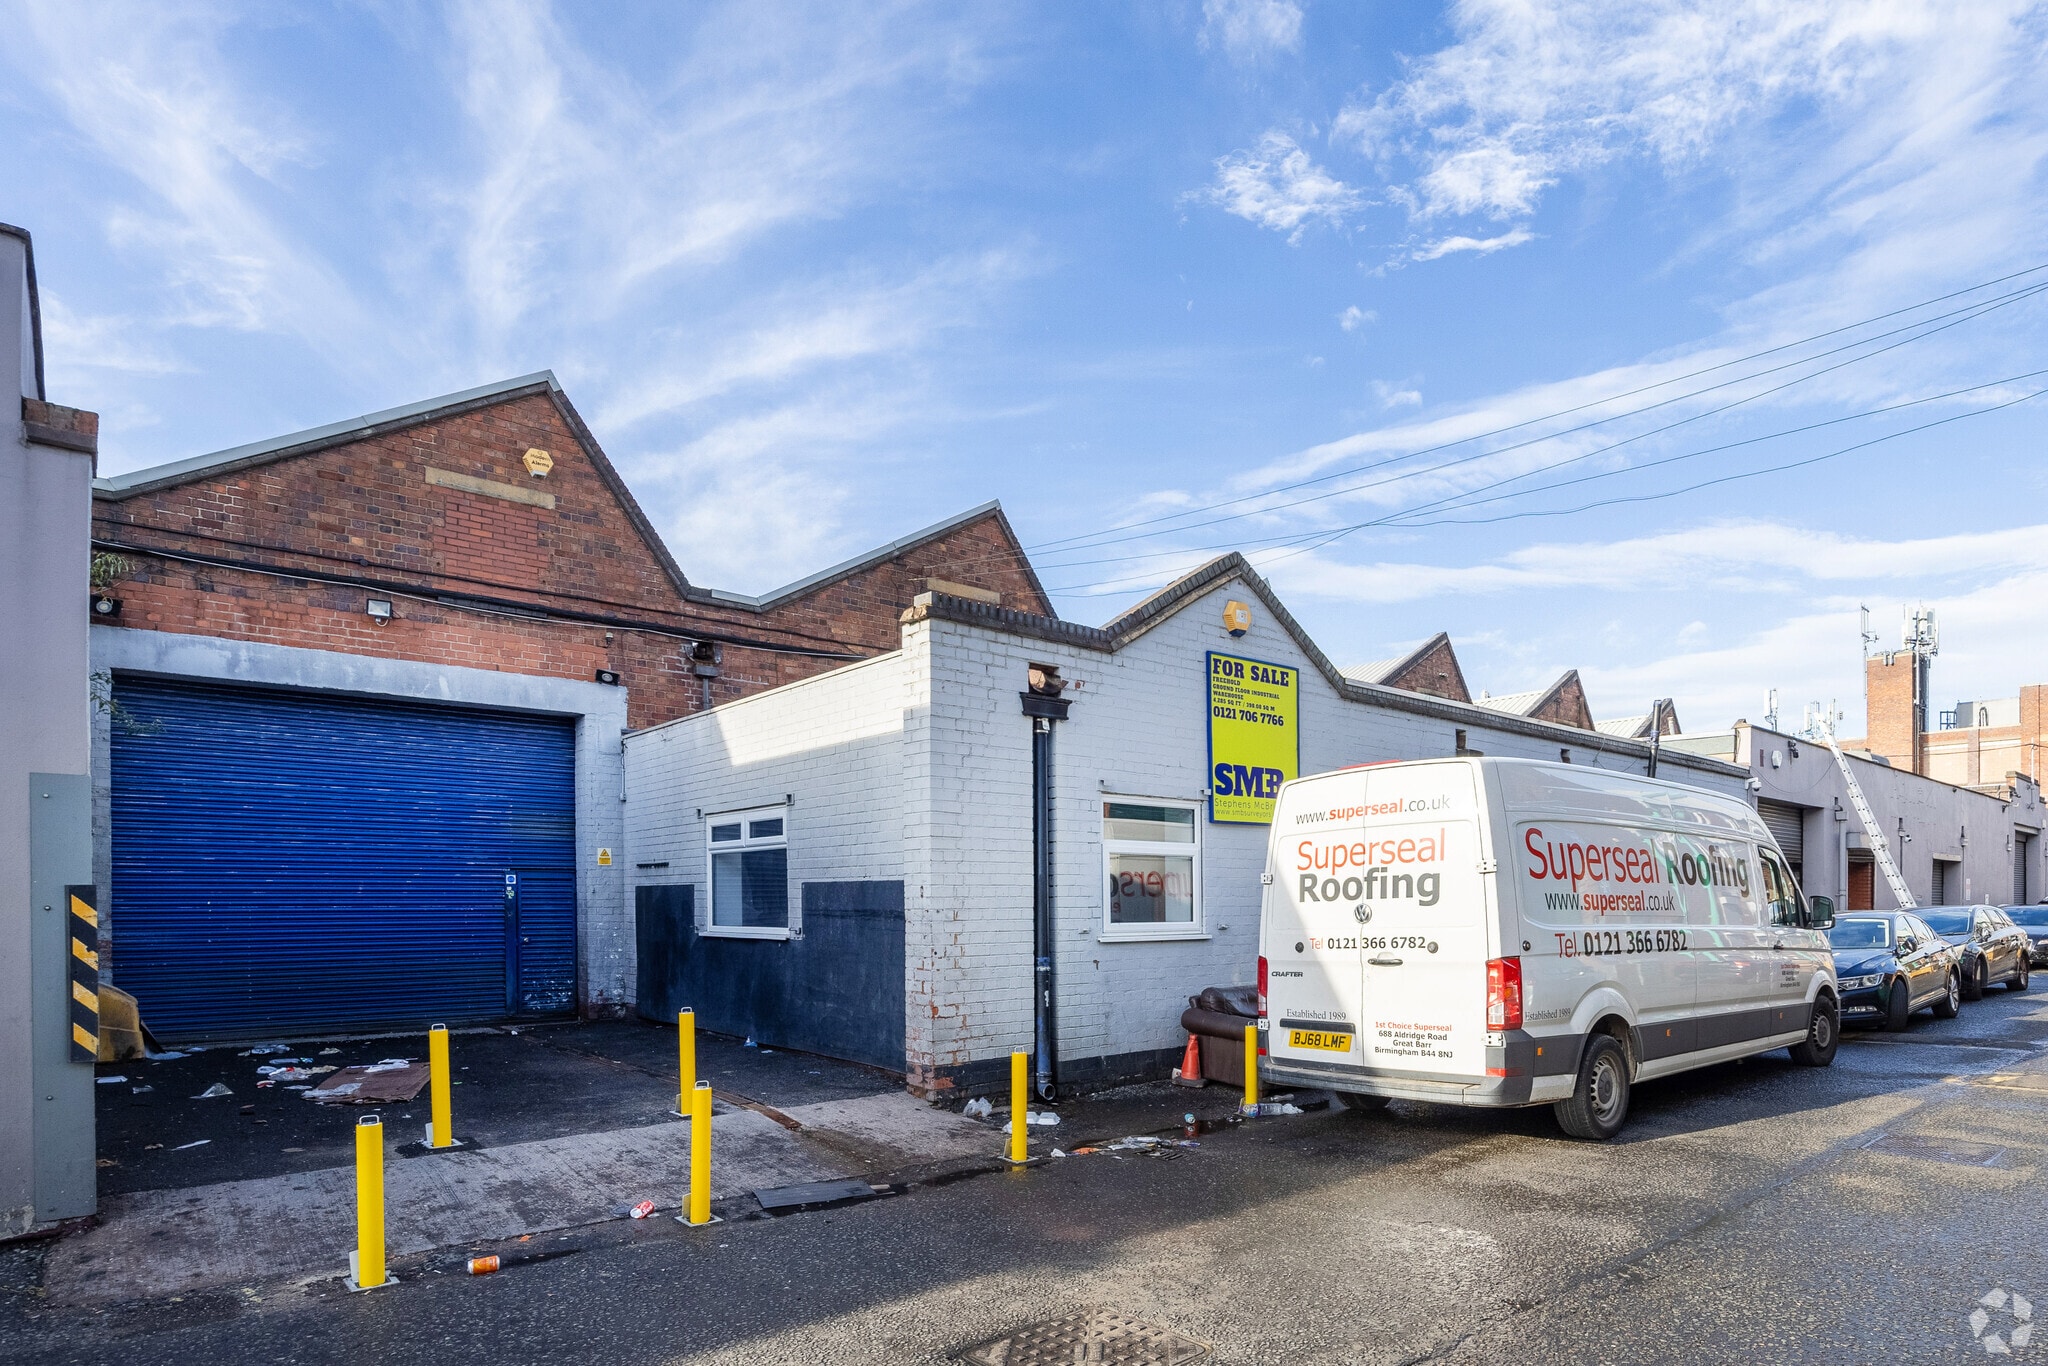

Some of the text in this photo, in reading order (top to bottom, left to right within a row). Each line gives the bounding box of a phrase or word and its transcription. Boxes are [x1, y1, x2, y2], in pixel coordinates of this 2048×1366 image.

[1213, 657, 1289, 687] FOR SALE
[1213, 676, 1240, 686] FREEHOLD
[1213, 684, 1234, 692] GROUND
[1252, 690, 1280, 699] INDUSTRIAL
[1213, 690, 1244, 700] WAREHOUSE
[1213, 706, 1284, 727] 0121 706 7766
[1214, 762, 1284, 799] SMB
[1215, 798, 1273, 810] Stephens McBr
[1296, 794, 1451, 825] www.superseal.co.uk
[1215, 808, 1272, 818] www.smbsurveyors
[1297, 827, 1445, 876] Superseal
[1524, 827, 1750, 898] Superseal Roofing
[1299, 866, 1441, 907] Roofing
[1544, 890, 1676, 916] www.superseal.co.uk
[1310, 936, 1426, 950] Tel 0121 366 6782
[1583, 931, 1622, 957] 0121
[1626, 930, 1653, 955] 366
[1656, 929, 1688, 953] 6782
[1286, 1008, 1347, 1021] Established 1989
[1525, 1009, 1558, 1021] Established
[1375, 1021, 1453, 1032] 1st Choice Superseal
[1294, 1032, 1346, 1048] BJ68 LMF
[1394, 1031, 1425, 1040] Aldridge
[1427, 1033, 1448, 1041] Road
[1374, 1046, 1419, 1056] Birmingham
[1393, 1039, 1432, 1049] Great Barr
